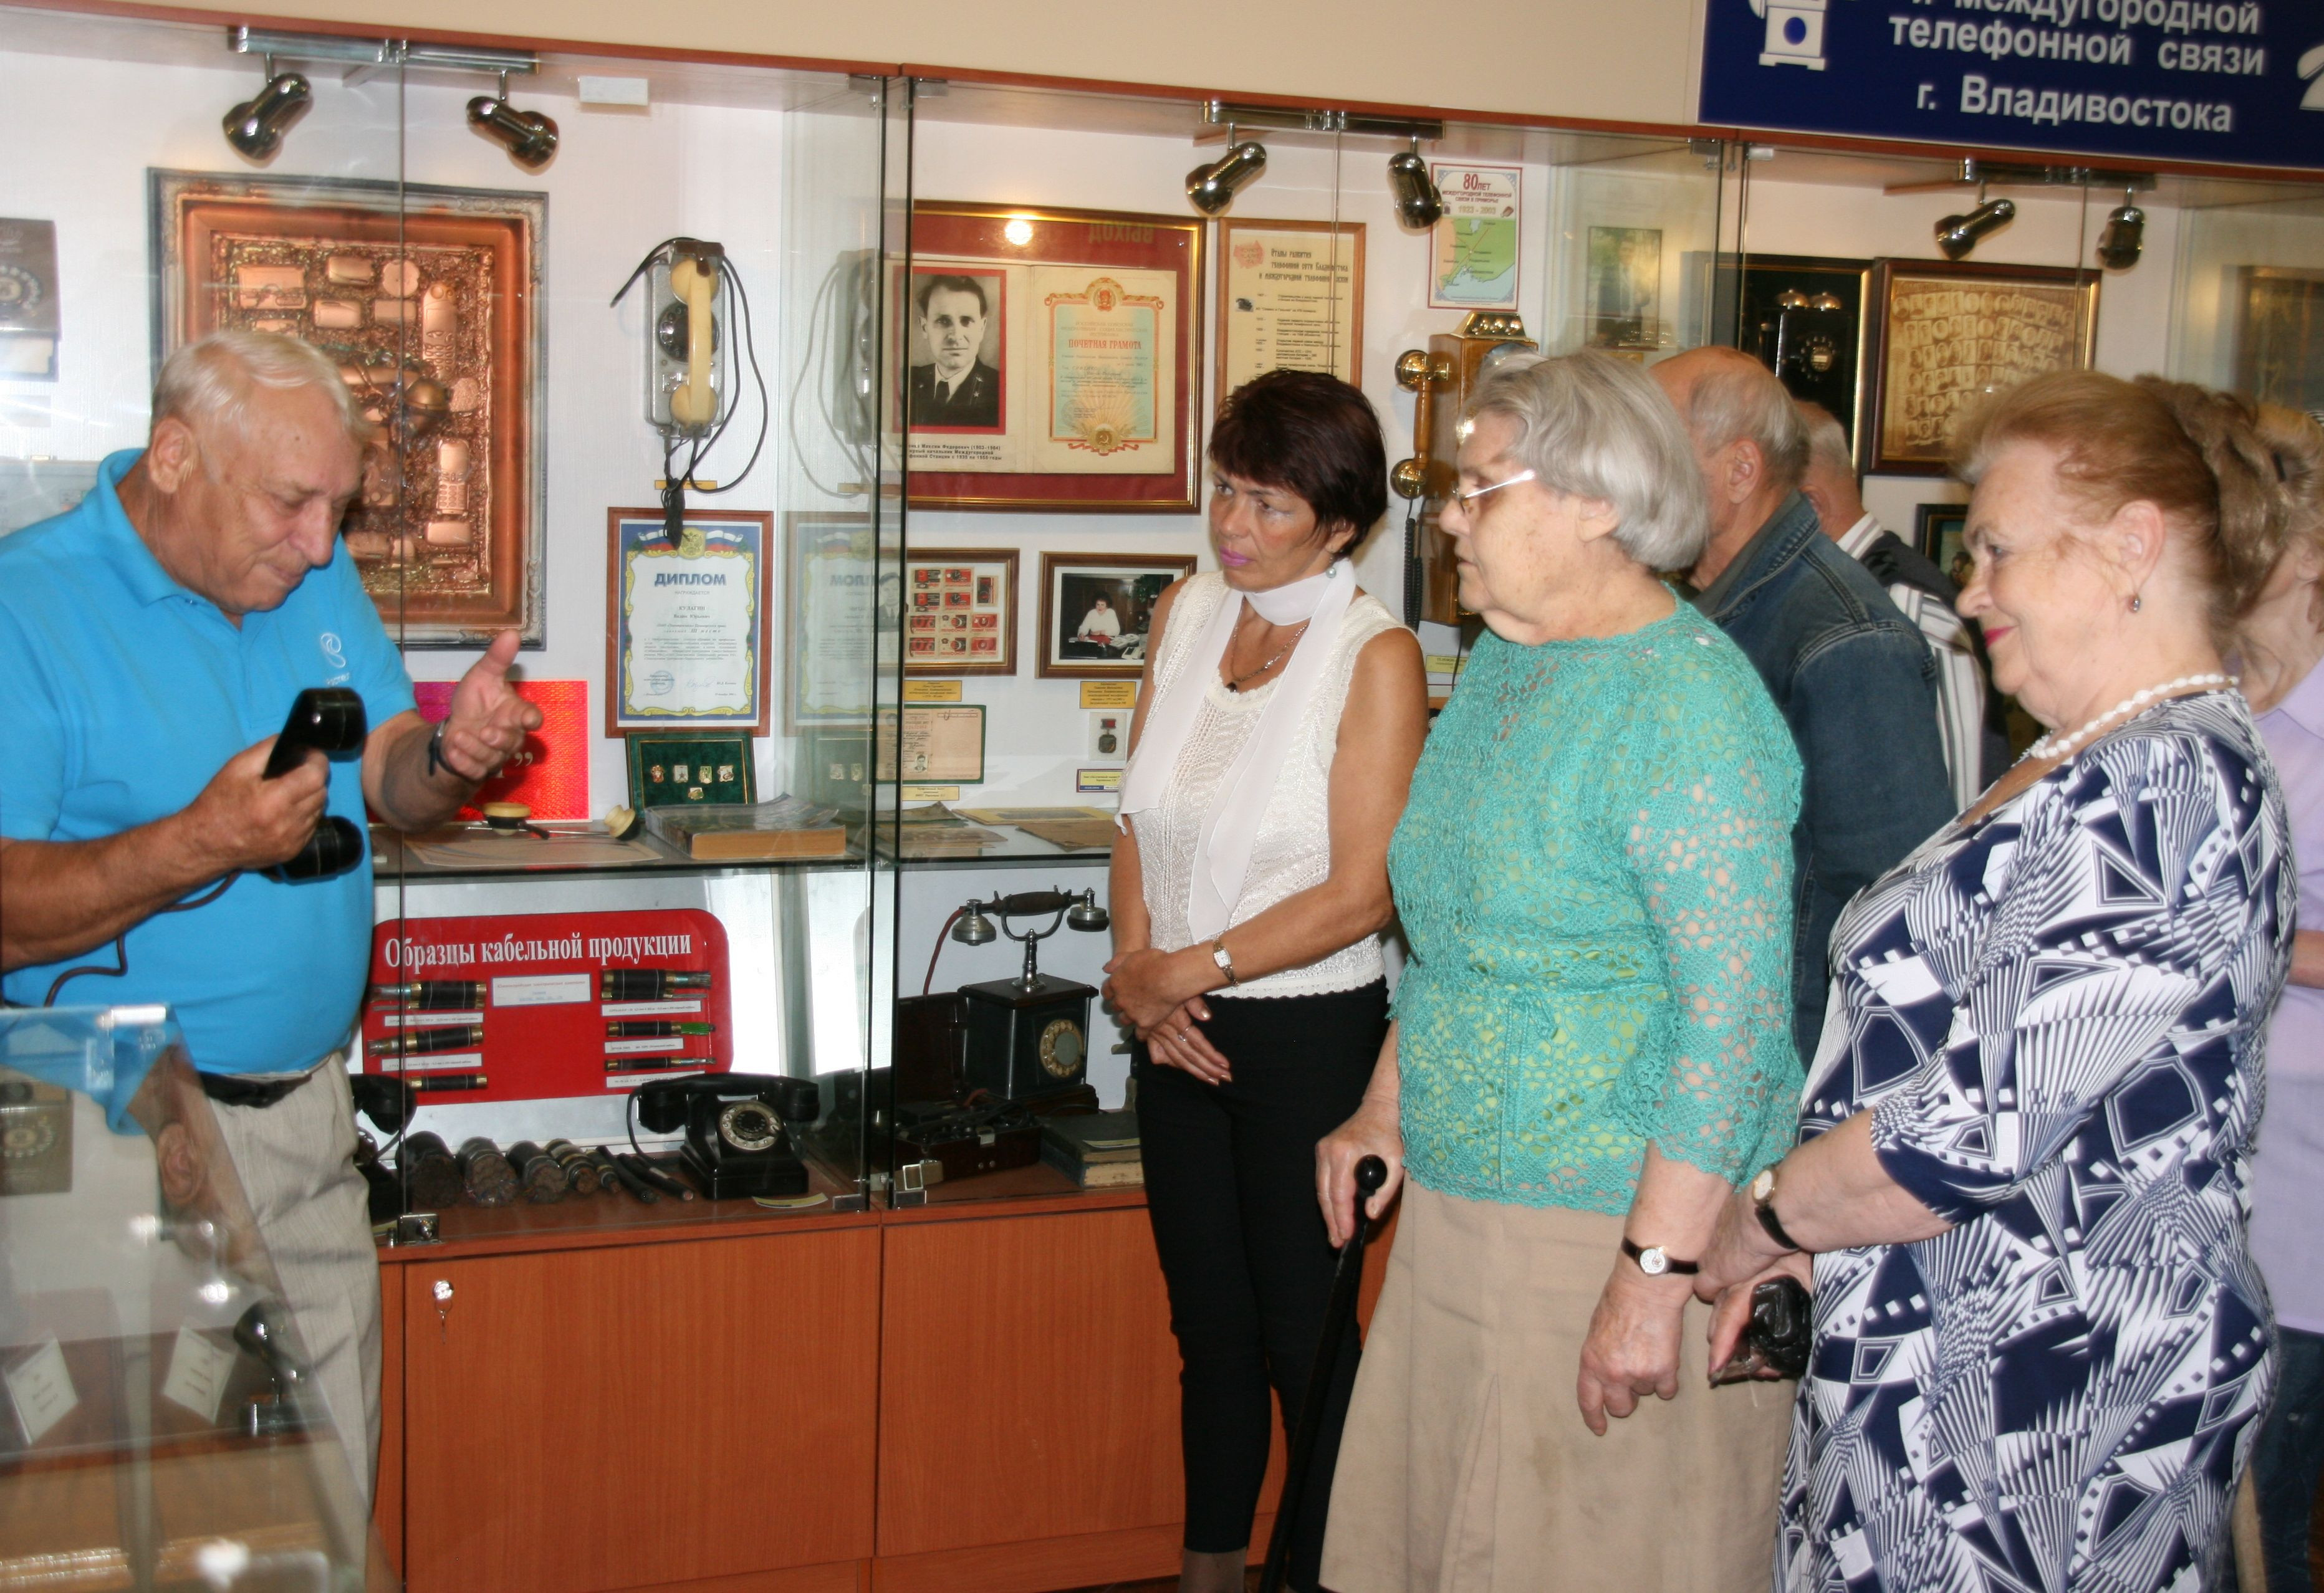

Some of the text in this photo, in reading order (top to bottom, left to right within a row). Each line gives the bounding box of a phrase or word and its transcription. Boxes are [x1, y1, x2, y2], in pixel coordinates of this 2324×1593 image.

[1955, 0, 2260, 35] дугородной
[1888, 16, 2265, 75] телефонной связи
[1916, 74, 2232, 133] г. Владивостока
[1110, 340, 1141, 350] ГРАМОТА
[655, 573, 726, 587] ДИПЛОМ
[385, 932, 692, 974] Образцы кабельной продукции
